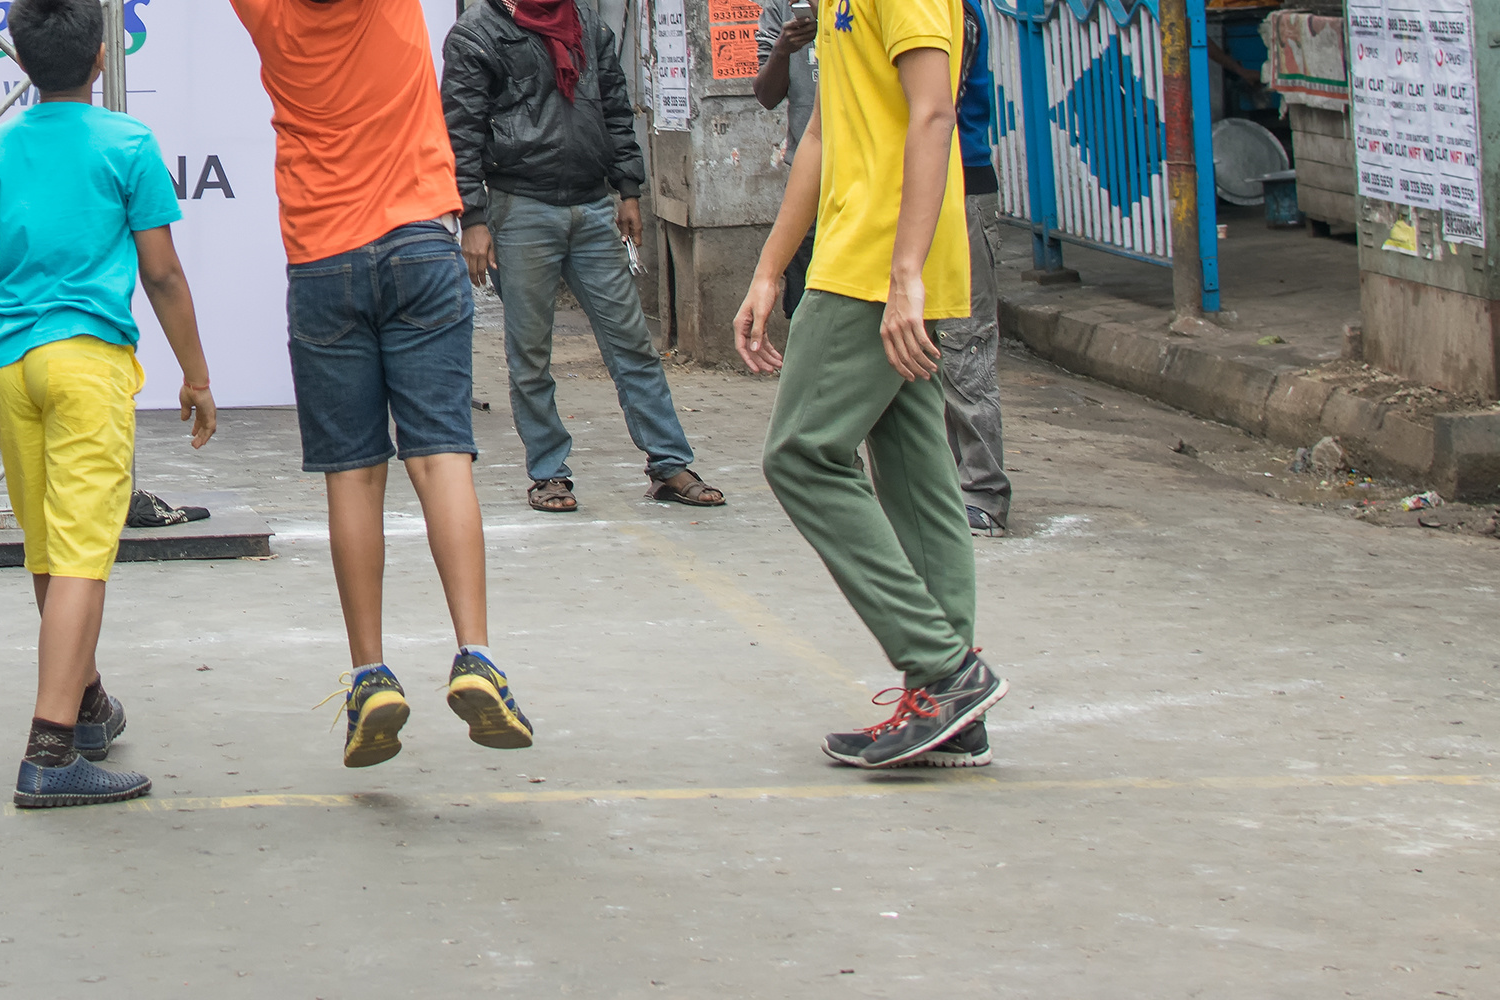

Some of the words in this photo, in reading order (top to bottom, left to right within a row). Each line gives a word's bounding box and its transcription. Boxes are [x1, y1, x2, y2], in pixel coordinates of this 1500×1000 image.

[715, 30, 736, 41] JOB
[740, 29, 750, 39] IN
[1365, 46, 1378, 58] OPUS
[1403, 51, 1419, 63] OPUS
[1445, 53, 1461, 65] OPUS
[1368, 78, 1383, 91] CLAT
[1408, 83, 1424, 97] CLAT
[1451, 85, 1466, 99] CLAT
[1395, 143, 1407, 158] CLAT
[1435, 146, 1448, 161] CLAT
